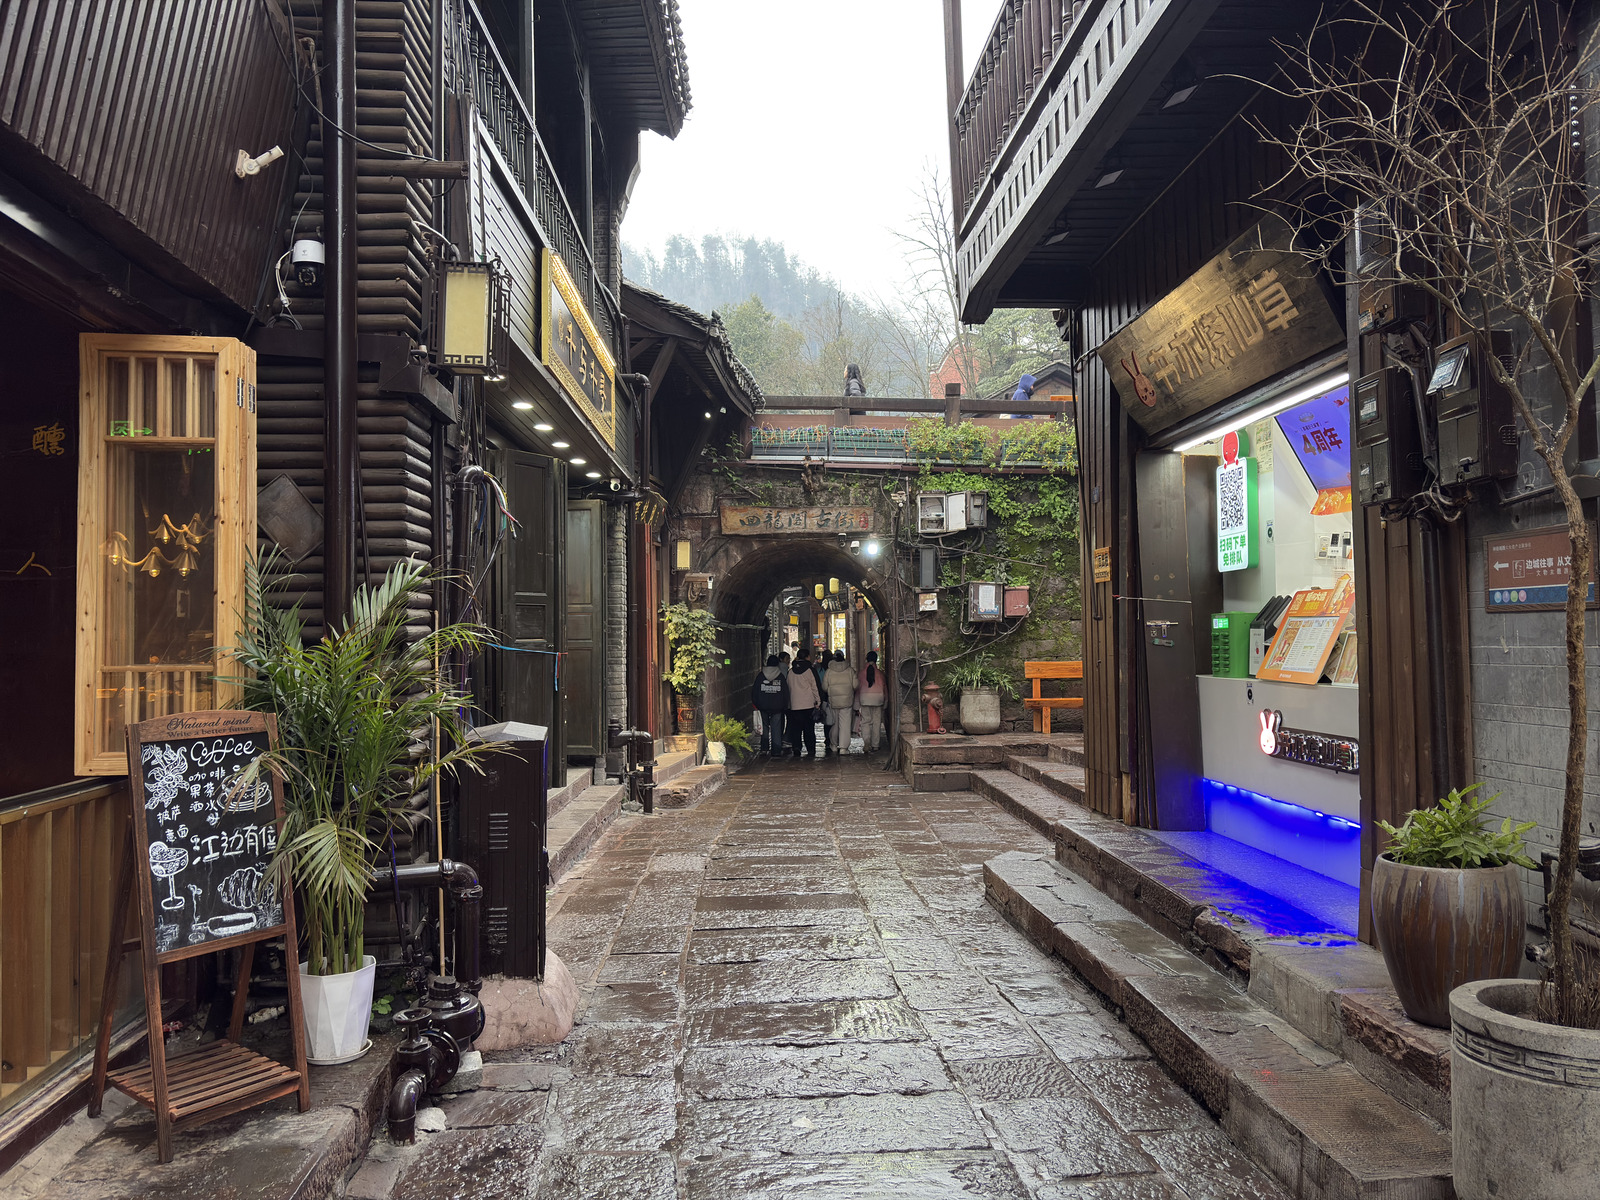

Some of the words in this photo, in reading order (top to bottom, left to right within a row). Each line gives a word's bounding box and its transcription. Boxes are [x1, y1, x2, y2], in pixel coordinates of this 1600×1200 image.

[1302, 427, 1343, 456] 4周年
[1220, 534, 1246, 552] 扫码下单
[1223, 550, 1243, 566] 免排队
[1525, 557, 1554, 570] 边城往事
[167, 716, 220, 731] Natural
[222, 714, 252, 726] wind
[228, 725, 255, 733] future
[190, 738, 256, 767] Coffee
[188, 767, 226, 781] 咖啡
[190, 782, 215, 798] 果茶
[157, 804, 182, 826] 披萨
[165, 824, 189, 843] 意面
[190, 823, 277, 866] 江边有位
